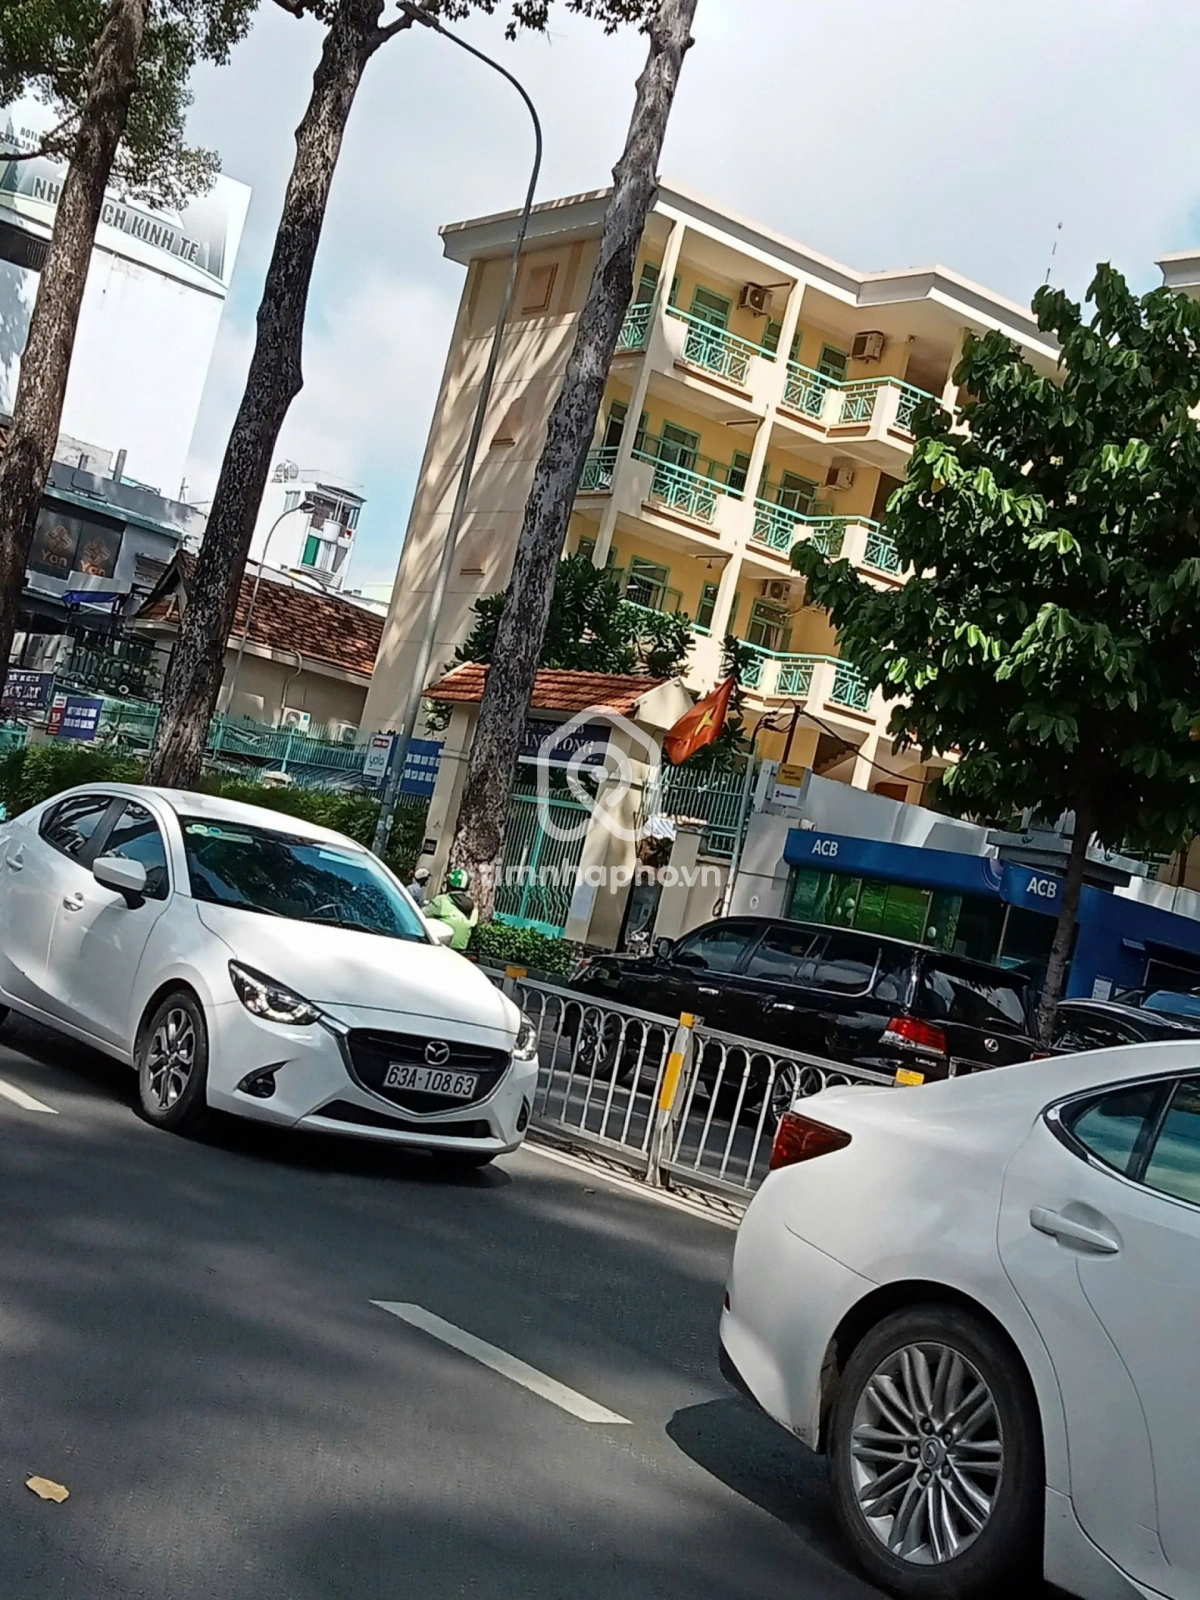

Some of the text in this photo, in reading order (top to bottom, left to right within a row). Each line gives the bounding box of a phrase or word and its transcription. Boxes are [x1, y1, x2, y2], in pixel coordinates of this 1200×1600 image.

[34, 177, 60, 204] NH
[131, 215, 174, 251] KINH
[42, 549, 68, 567] Yan
[554, 736, 594, 754] LONG
[811, 839, 839, 857] ACB
[1026, 876, 1057, 898] ACB
